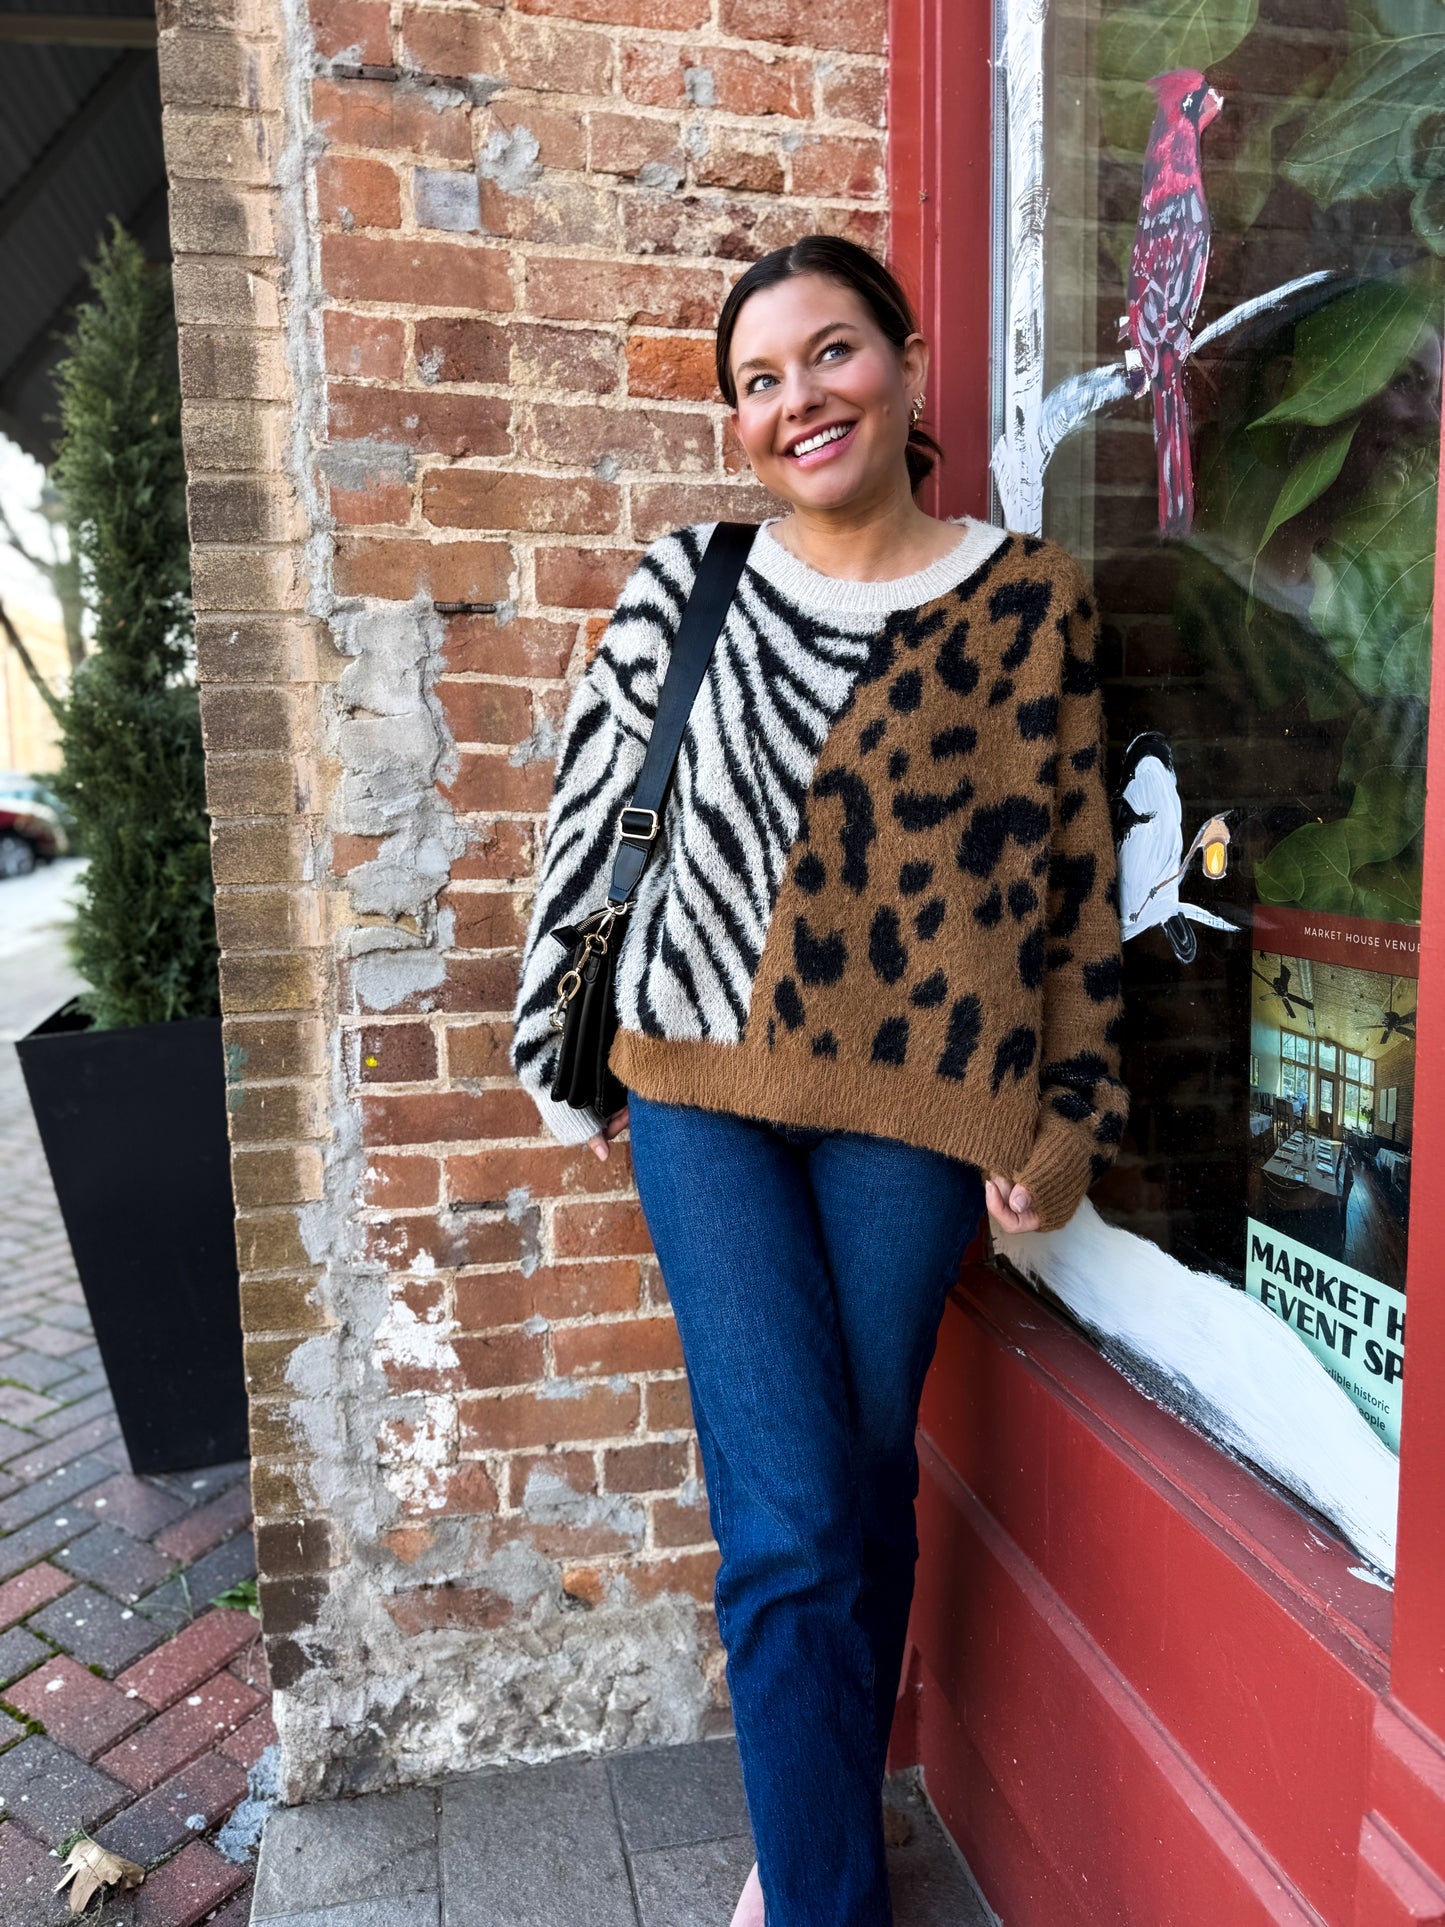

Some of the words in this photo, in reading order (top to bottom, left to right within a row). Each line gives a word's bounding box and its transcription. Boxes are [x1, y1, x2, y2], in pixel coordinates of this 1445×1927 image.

[1304, 927, 1341, 940] MARKET
[1346, 933, 1380, 947] HOUSE
[1252, 1234, 1380, 1328] MARKET
[1261, 1278, 1358, 1358] EVENT
[1354, 1383, 1390, 1414] historic
